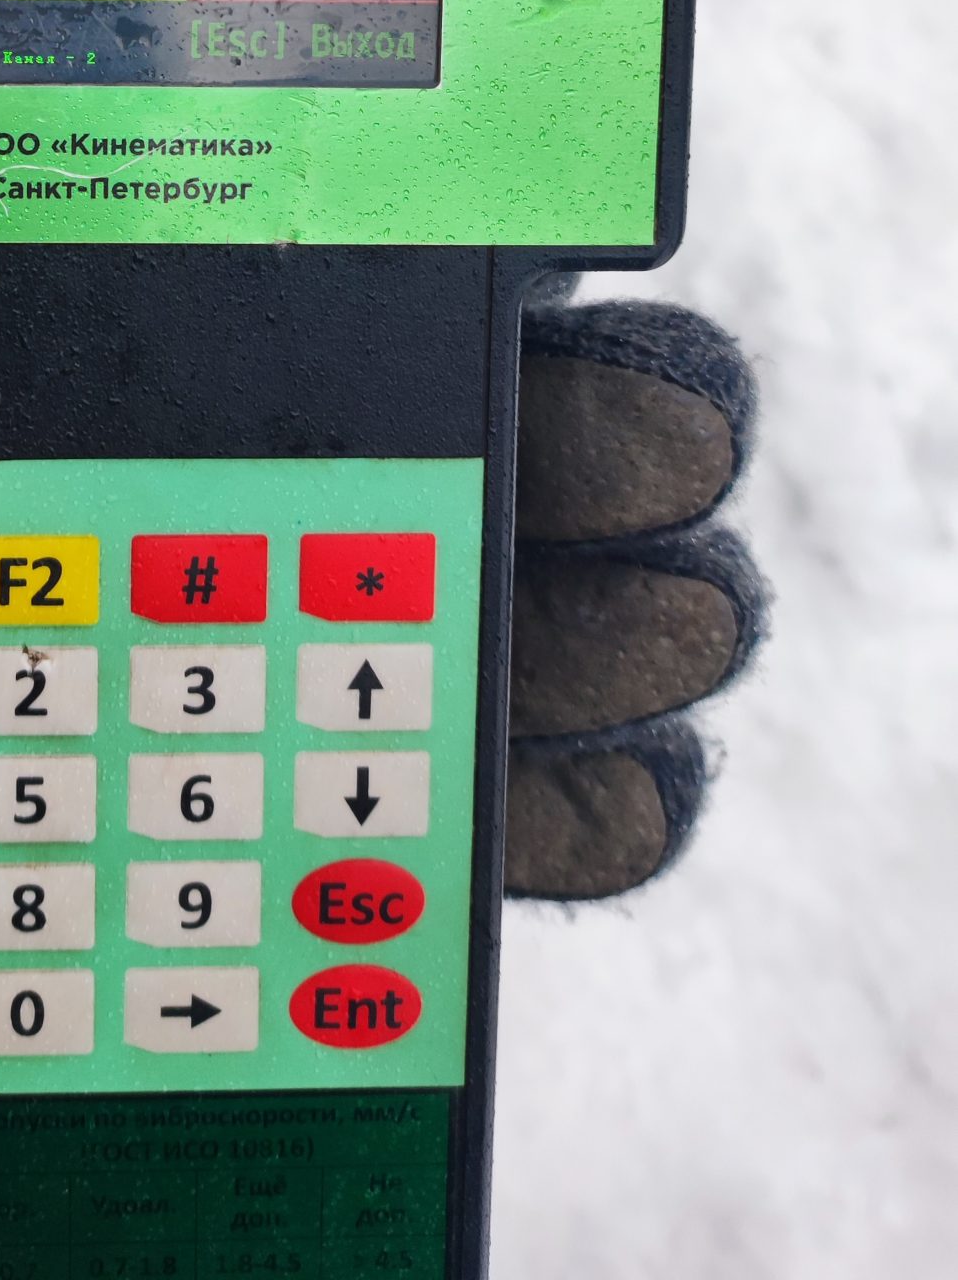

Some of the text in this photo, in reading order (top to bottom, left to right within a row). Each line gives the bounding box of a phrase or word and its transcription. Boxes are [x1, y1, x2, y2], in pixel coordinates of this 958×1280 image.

[3, 51, 55, 65] Канал
[87, 52, 96, 64] 2
[191, 20, 415, 60] [Esc] Выход
[51, 133, 273, 157] «Кинематика»
[0, 557, 65, 607] F2
[14, 669, 48, 717] 2
[183, 666, 217, 714] 3
[13, 776, 47, 824] 5
[180, 774, 215, 822] 6
[11, 884, 47, 932] 8
[177, 881, 213, 929] 9
[318, 882, 405, 926] Esc
[9, 989, 45, 1037] 0
[313, 987, 404, 1030] Ent
[163, 1140, 219, 1161] ИСО
[227, 1135, 315, 1161] 10816)
